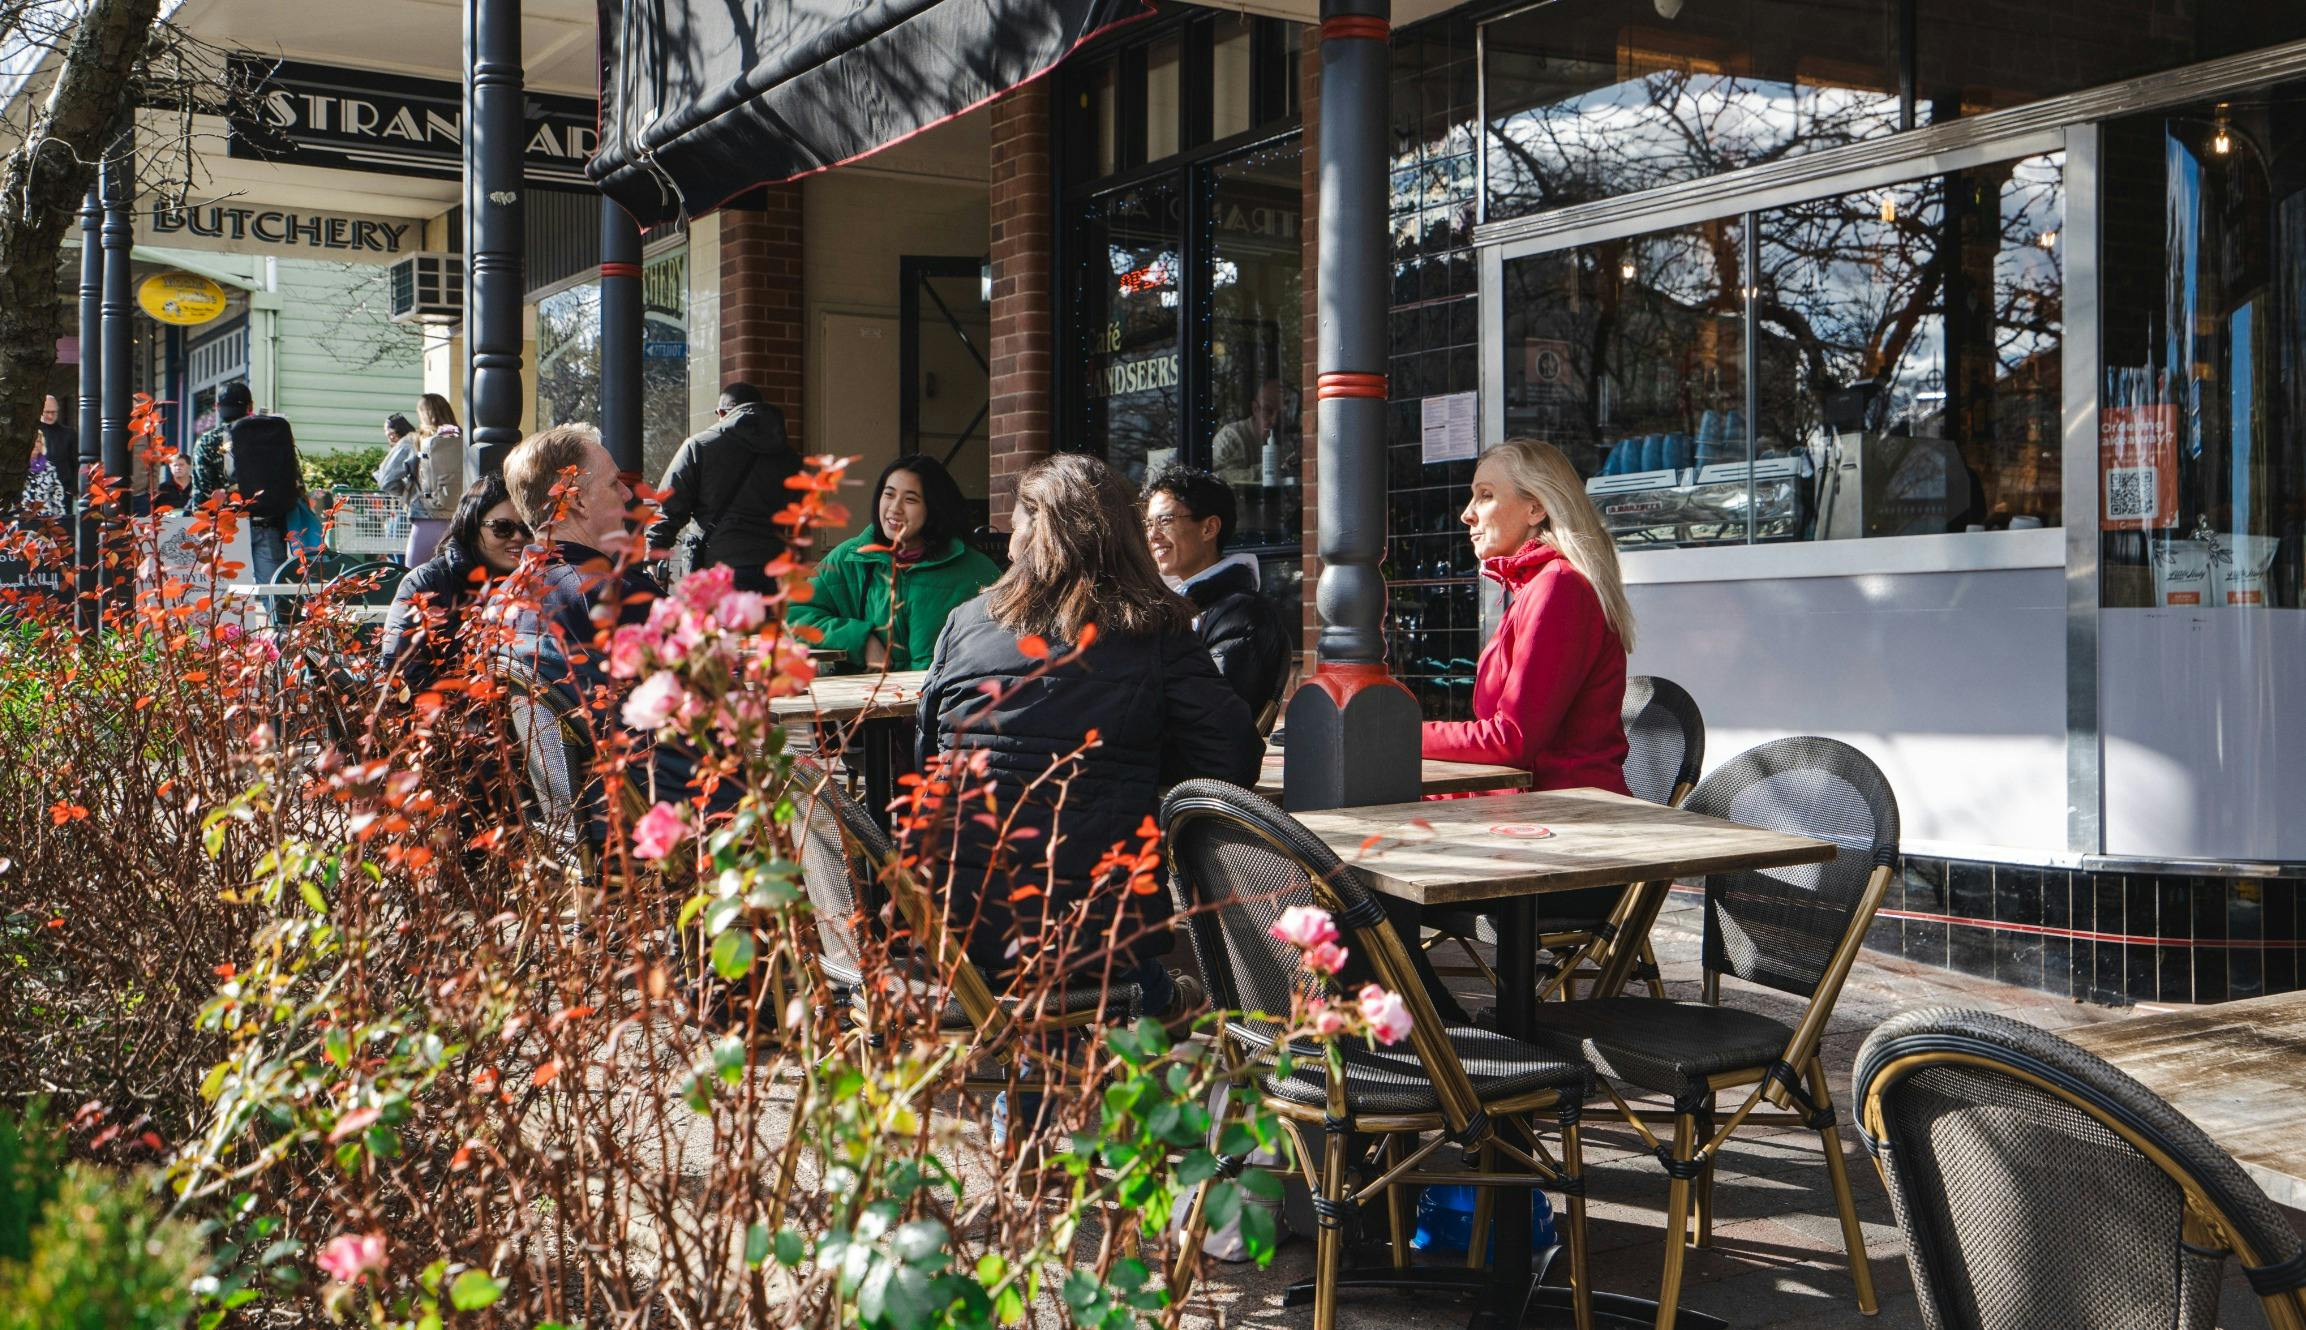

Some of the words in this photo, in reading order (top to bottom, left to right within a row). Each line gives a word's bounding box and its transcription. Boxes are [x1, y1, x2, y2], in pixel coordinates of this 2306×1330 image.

[265, 90, 461, 146] STRAN
[524, 122, 598, 160] AR
[153, 202, 409, 252] BUTCHERY
[2101, 431, 2174, 446] akeaway?
